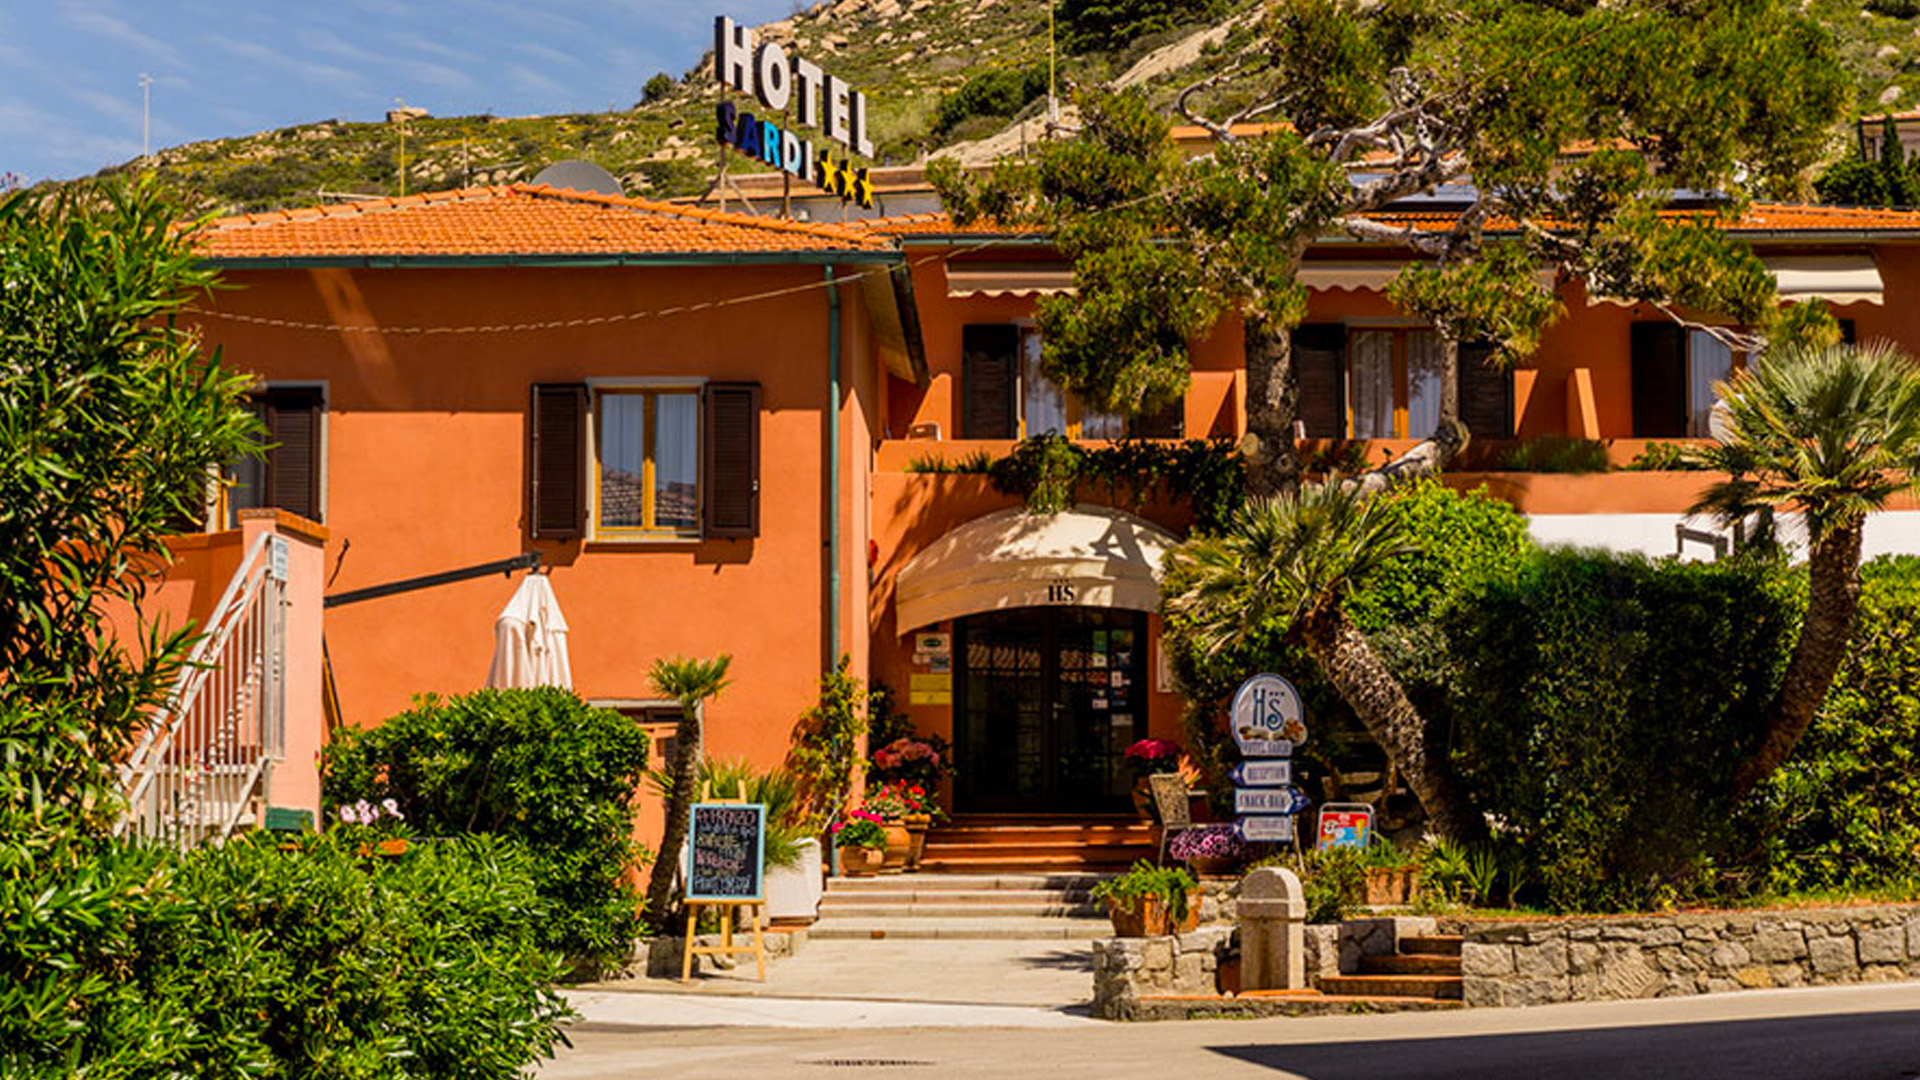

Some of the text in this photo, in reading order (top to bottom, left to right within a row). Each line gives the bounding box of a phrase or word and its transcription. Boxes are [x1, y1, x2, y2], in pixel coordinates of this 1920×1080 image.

[714, 15, 874, 159] HOTEL
[716, 101, 814, 182] SARDI
[1048, 584, 1074, 602] HS
